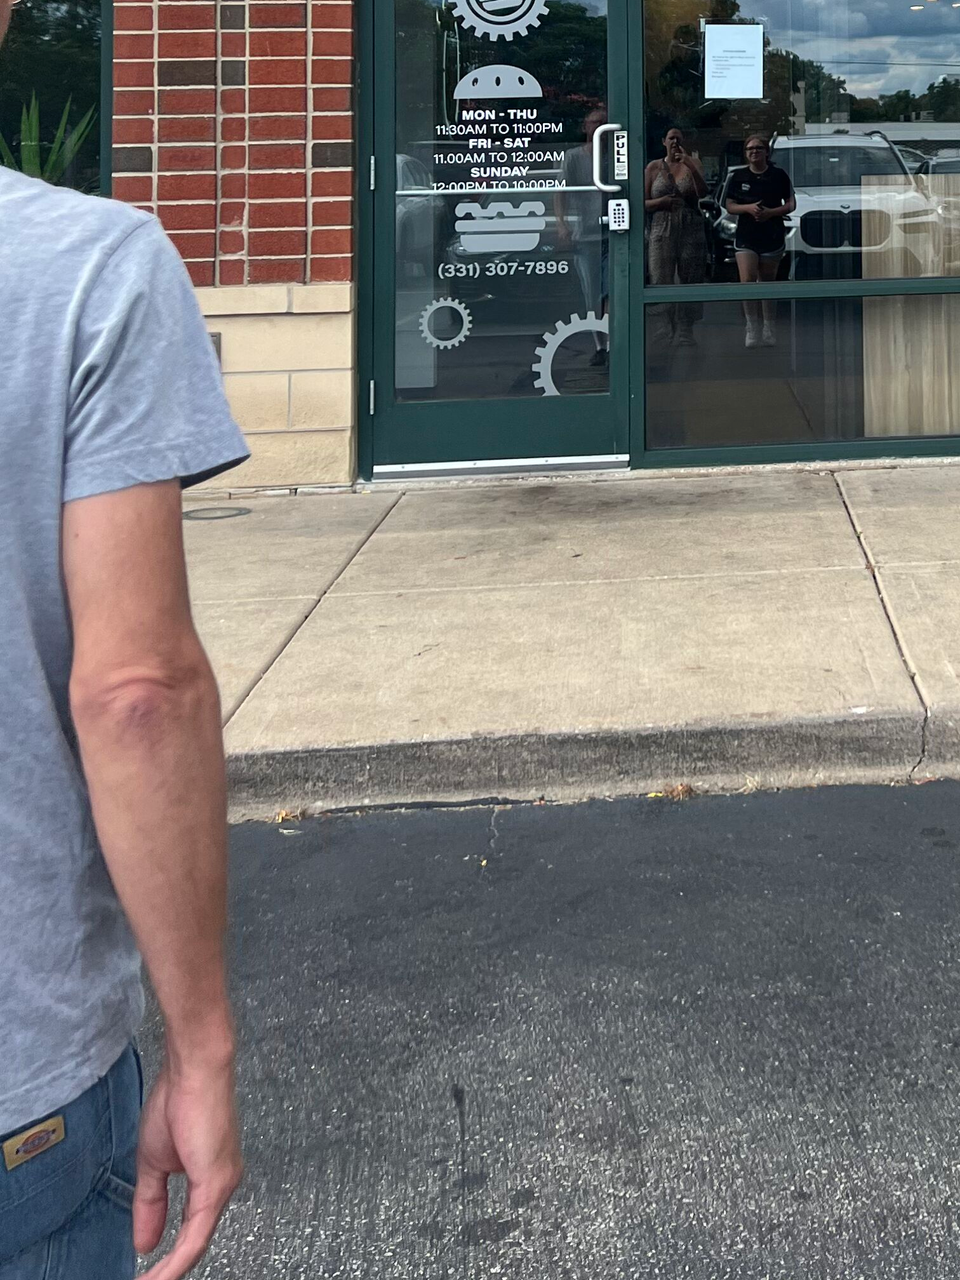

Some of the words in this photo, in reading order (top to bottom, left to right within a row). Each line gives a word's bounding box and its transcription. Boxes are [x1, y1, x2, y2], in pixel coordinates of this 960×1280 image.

[462, 110, 496, 120] MON
[507, 109, 537, 120] THU
[435, 124, 487, 135] 11:30AM
[490, 123, 510, 134] TO
[512, 122, 563, 133] 11:00PM
[468, 138, 492, 149] FRI
[503, 137, 531, 148] SAT
[616, 134, 626, 164] PULL
[489, 152, 508, 163] TO
[511, 151, 565, 162] 12:00AM
[470, 166, 530, 178] SUNDAY
[432, 182, 487, 191] 12:00PM
[490, 181, 509, 190] TO
[512, 179, 566, 190] 10:00PM
[438, 262, 480, 279] (331)
[485, 260, 569, 276] 307-7896
